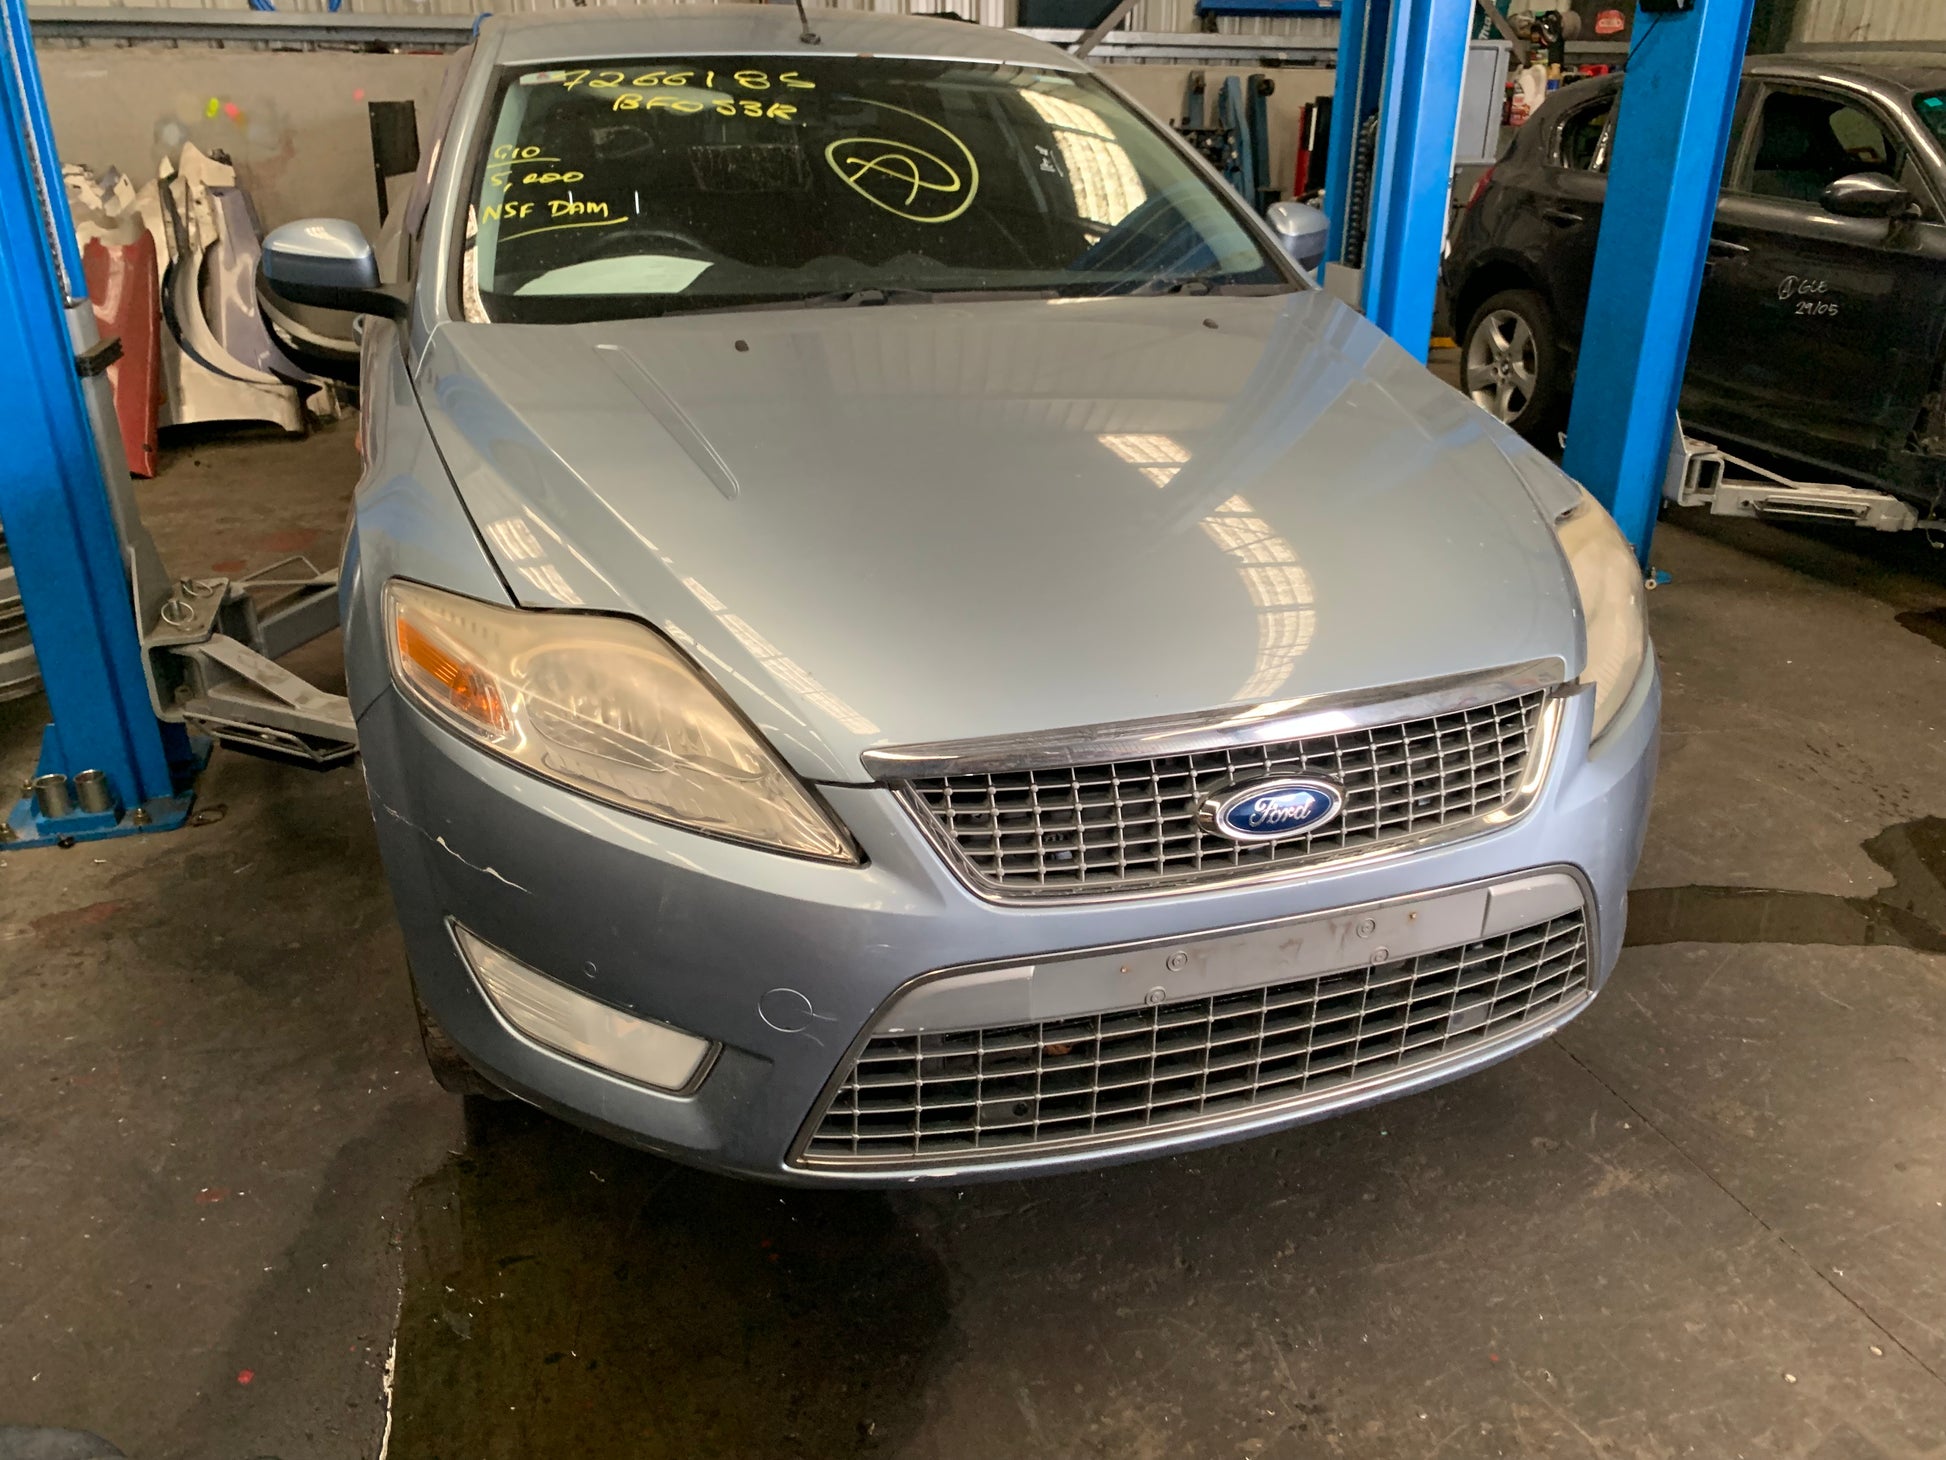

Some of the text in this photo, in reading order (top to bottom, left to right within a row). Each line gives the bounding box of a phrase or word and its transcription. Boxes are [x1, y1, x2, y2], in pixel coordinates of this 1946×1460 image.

[482, 201, 535, 225] NSF
[1795, 301, 1840, 317] 29/05
[1249, 796, 1315, 828] Ford
